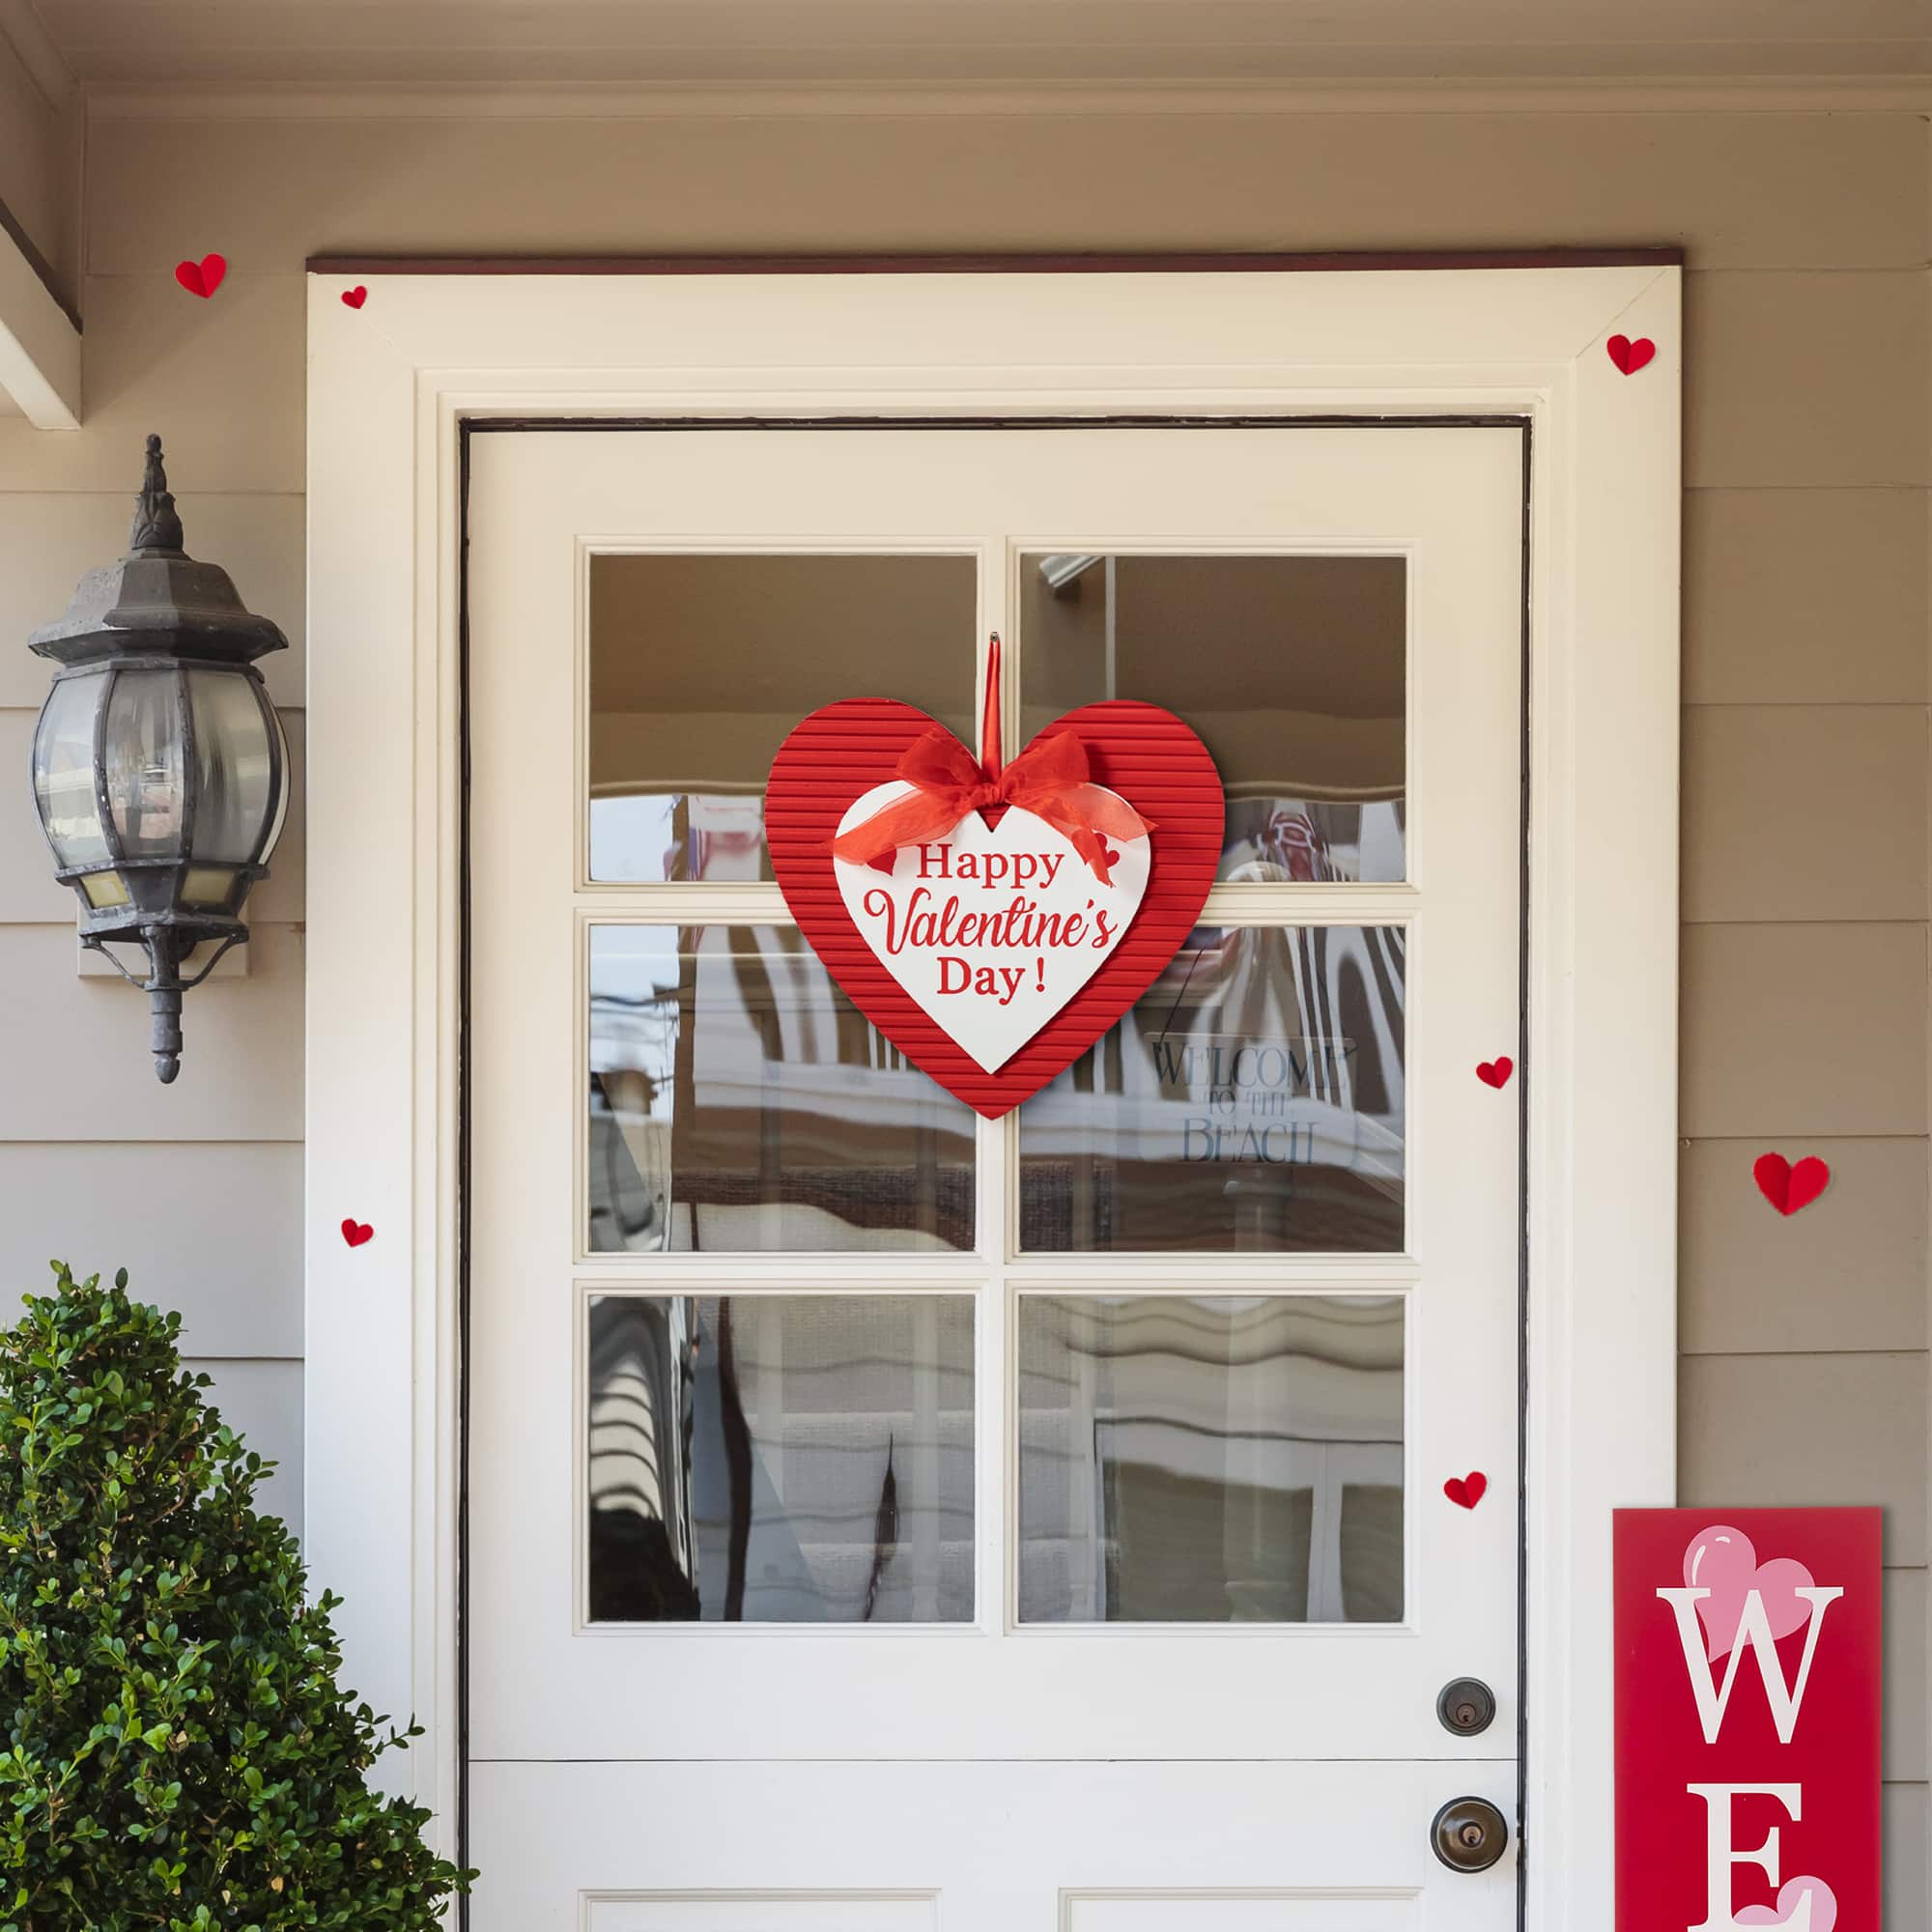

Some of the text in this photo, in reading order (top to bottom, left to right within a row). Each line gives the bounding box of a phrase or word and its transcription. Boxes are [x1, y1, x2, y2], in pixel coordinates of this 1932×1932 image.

[917, 843, 1065, 889] Happy
[863, 887, 1119, 954] Valentine's
[1208, 1090, 1237, 1115] TO
[1181, 1118, 1320, 1165] BEACH
